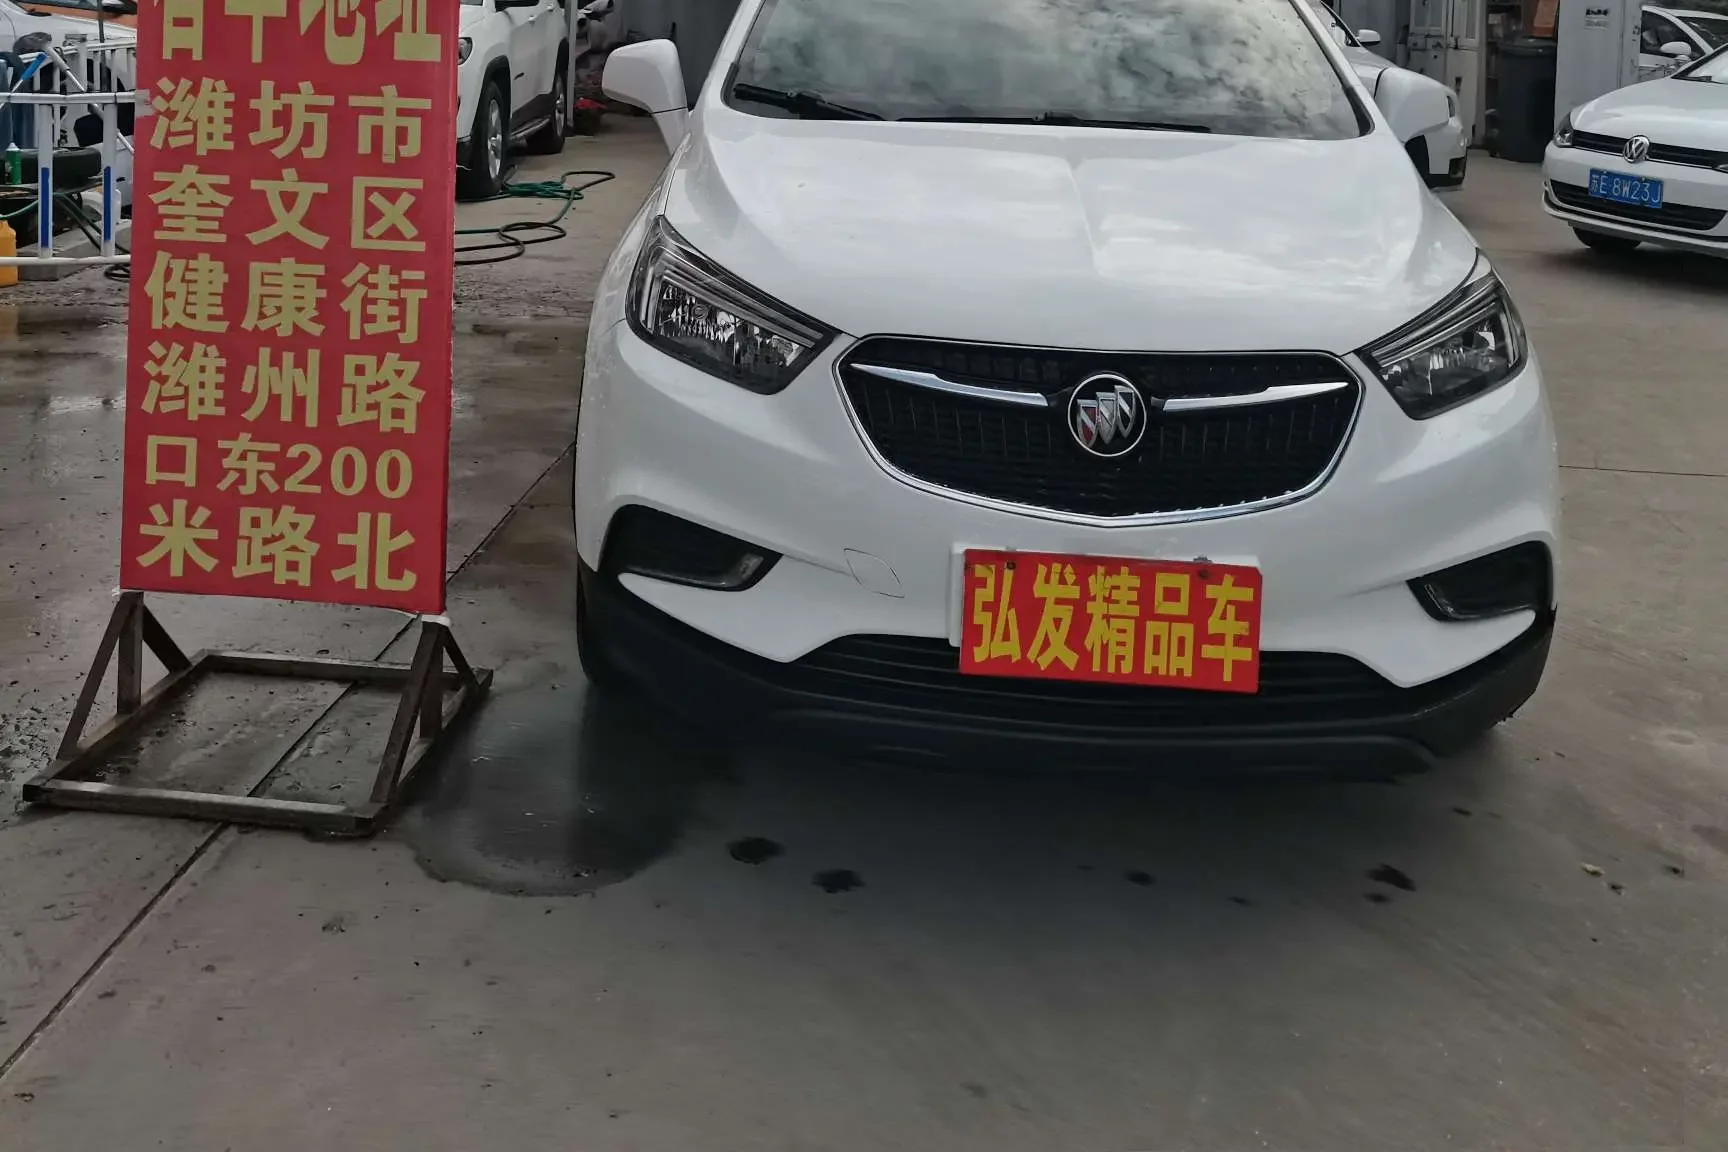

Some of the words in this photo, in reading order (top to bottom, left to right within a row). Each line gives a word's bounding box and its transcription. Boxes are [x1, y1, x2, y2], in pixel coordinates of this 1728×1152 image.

[148, 76, 432, 164] 潍坊市
[148, 163, 426, 253] 奎文区
[144, 250, 428, 344] 健康街
[140, 340, 426, 434] 潍州路
[144, 432, 414, 498] 口东200
[135, 498, 418, 592] 米路北
[972, 562, 1255, 682] 弘发精品车
